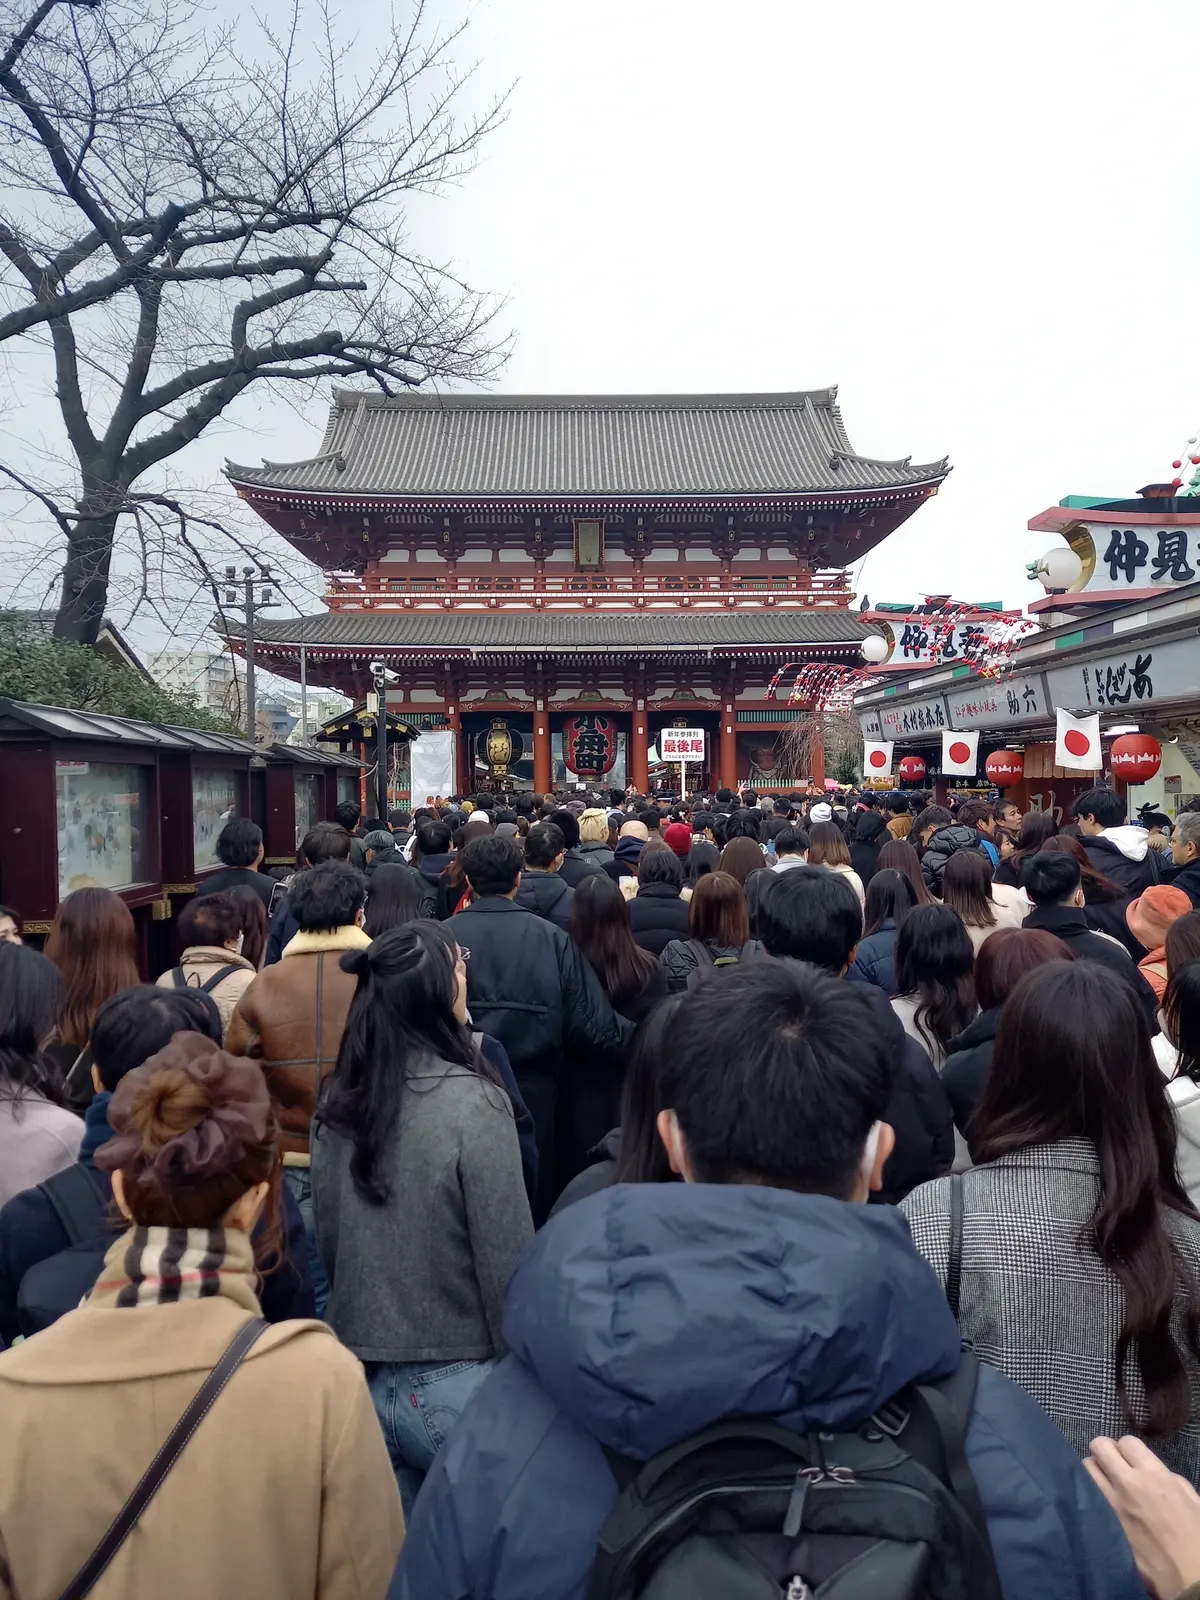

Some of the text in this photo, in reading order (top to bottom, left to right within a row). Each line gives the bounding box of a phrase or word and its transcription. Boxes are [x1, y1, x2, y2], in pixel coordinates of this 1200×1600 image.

[1103, 529, 1200, 583] 仲見
[1006, 684, 1037, 716] 助六
[663, 739, 704, 753] 最後尾
